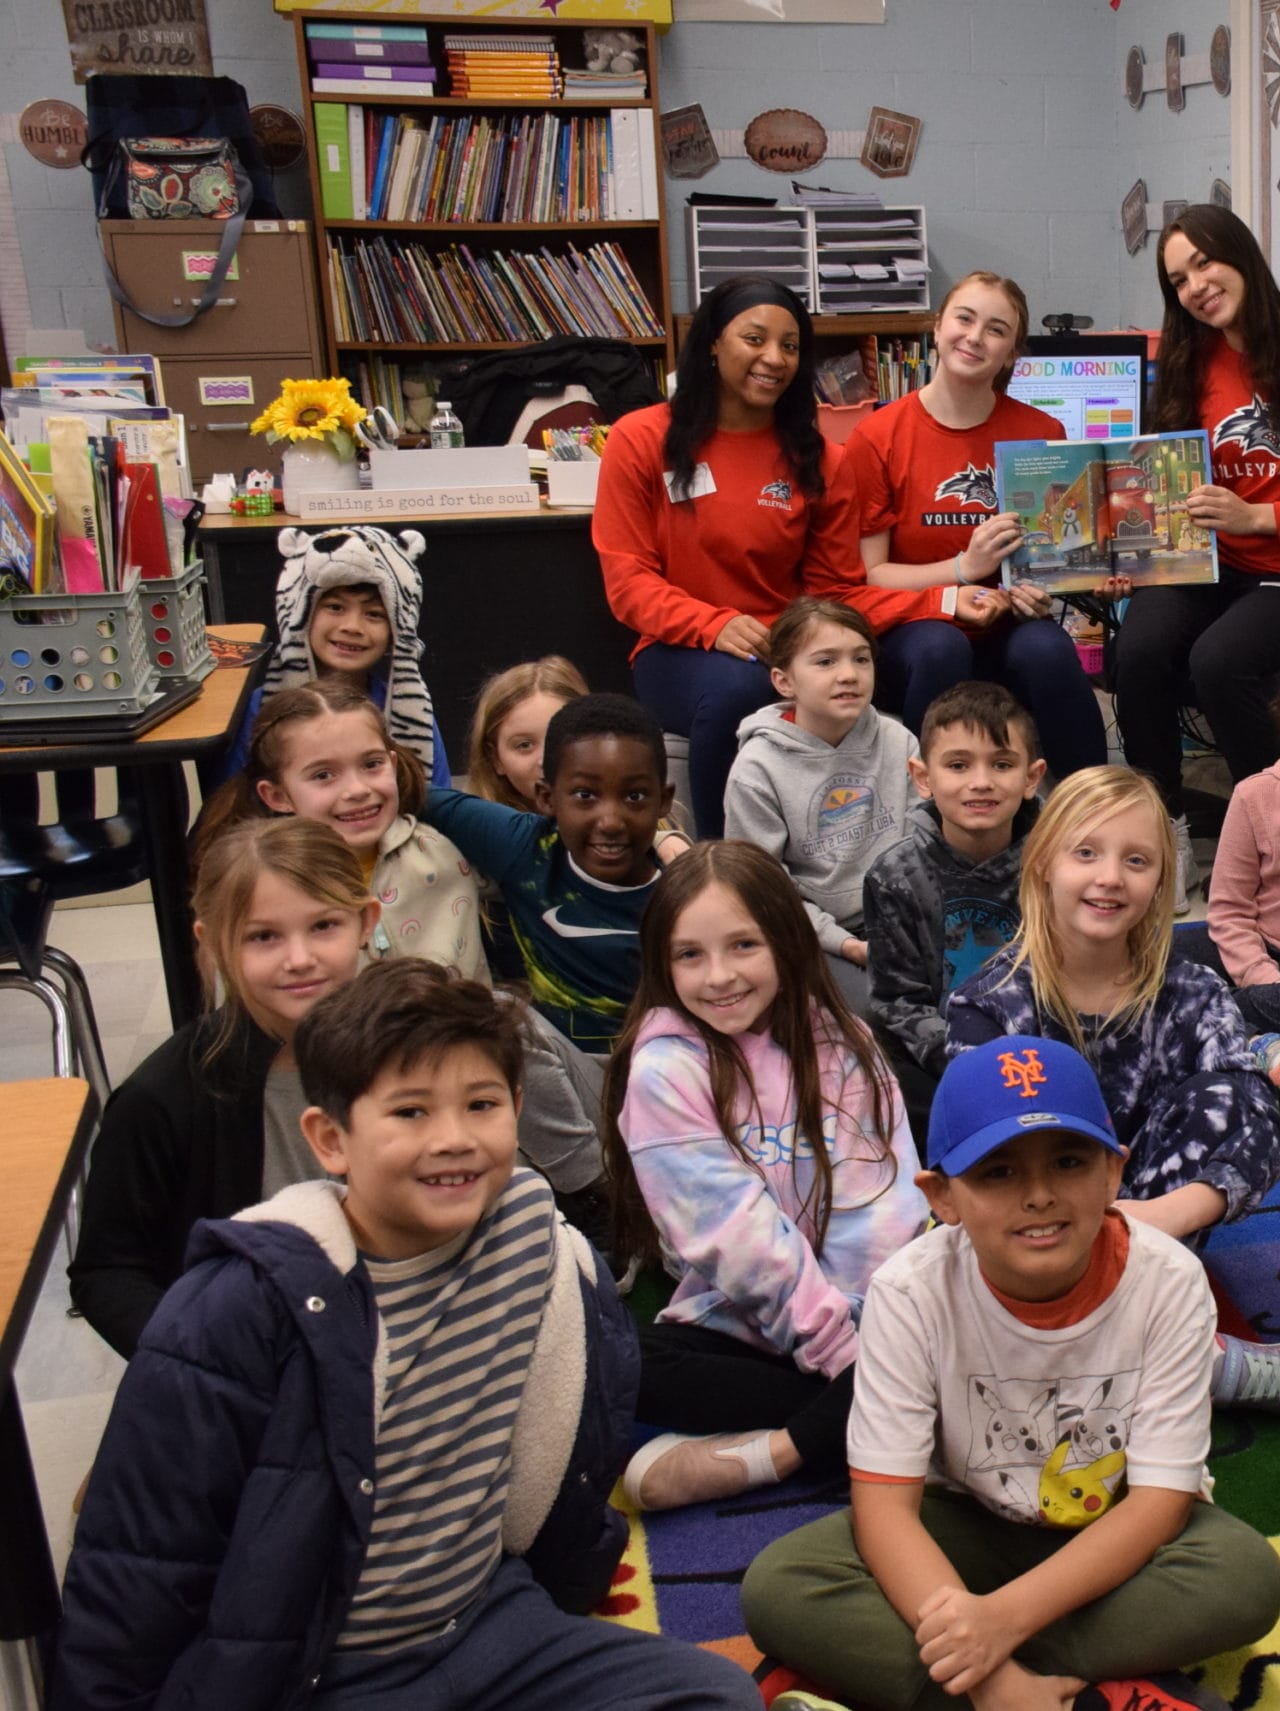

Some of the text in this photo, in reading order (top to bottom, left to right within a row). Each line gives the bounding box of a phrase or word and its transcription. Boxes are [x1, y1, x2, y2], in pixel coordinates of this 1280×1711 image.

[99, 34, 195, 66] share
[23, 125, 88, 146] HUMBL
[1013, 361, 1137, 378] GOOD MORNING
[308, 491, 534, 513] smiling is good for the soul
[757, 498, 792, 511] VOLLEYBALL
[924, 513, 995, 526] VOLLEYB
[84, 516, 97, 547] YAMA
[836, 826, 865, 845] COAST
[876, 812, 896, 830] USA
[997, 1048, 1048, 1098] NY
